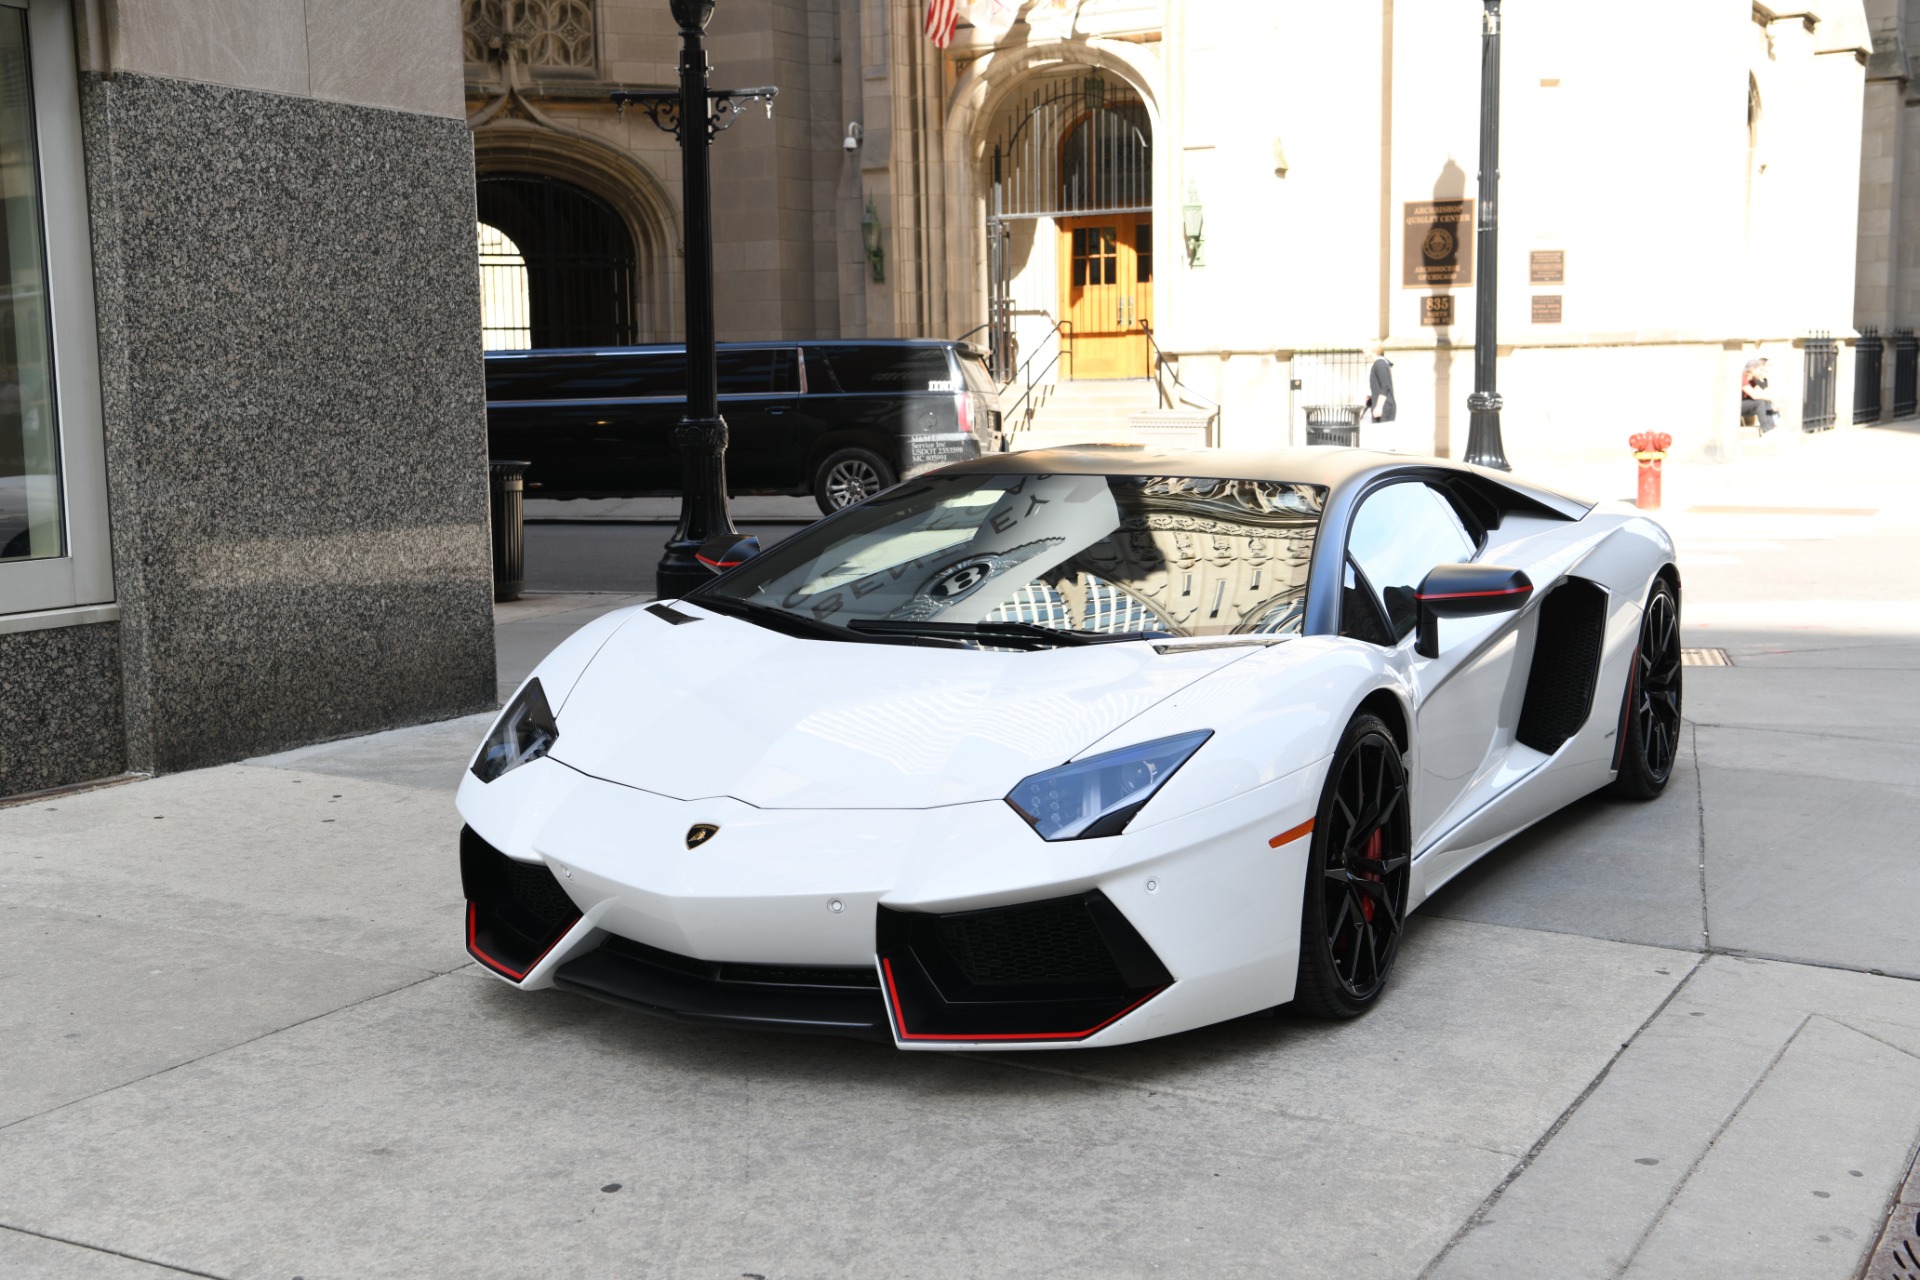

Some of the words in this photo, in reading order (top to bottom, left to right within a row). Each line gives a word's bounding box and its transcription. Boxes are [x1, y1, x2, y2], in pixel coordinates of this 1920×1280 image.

[1414, 205, 1463, 215] ARCHBISHOP
[1406, 216, 1439, 225] QUIGLEY
[1440, 214, 1471, 223] CENTER
[1428, 273, 1457, 281] CHICAGO
[1426, 297, 1449, 311] 835
[912, 448, 937, 456] USDOT
